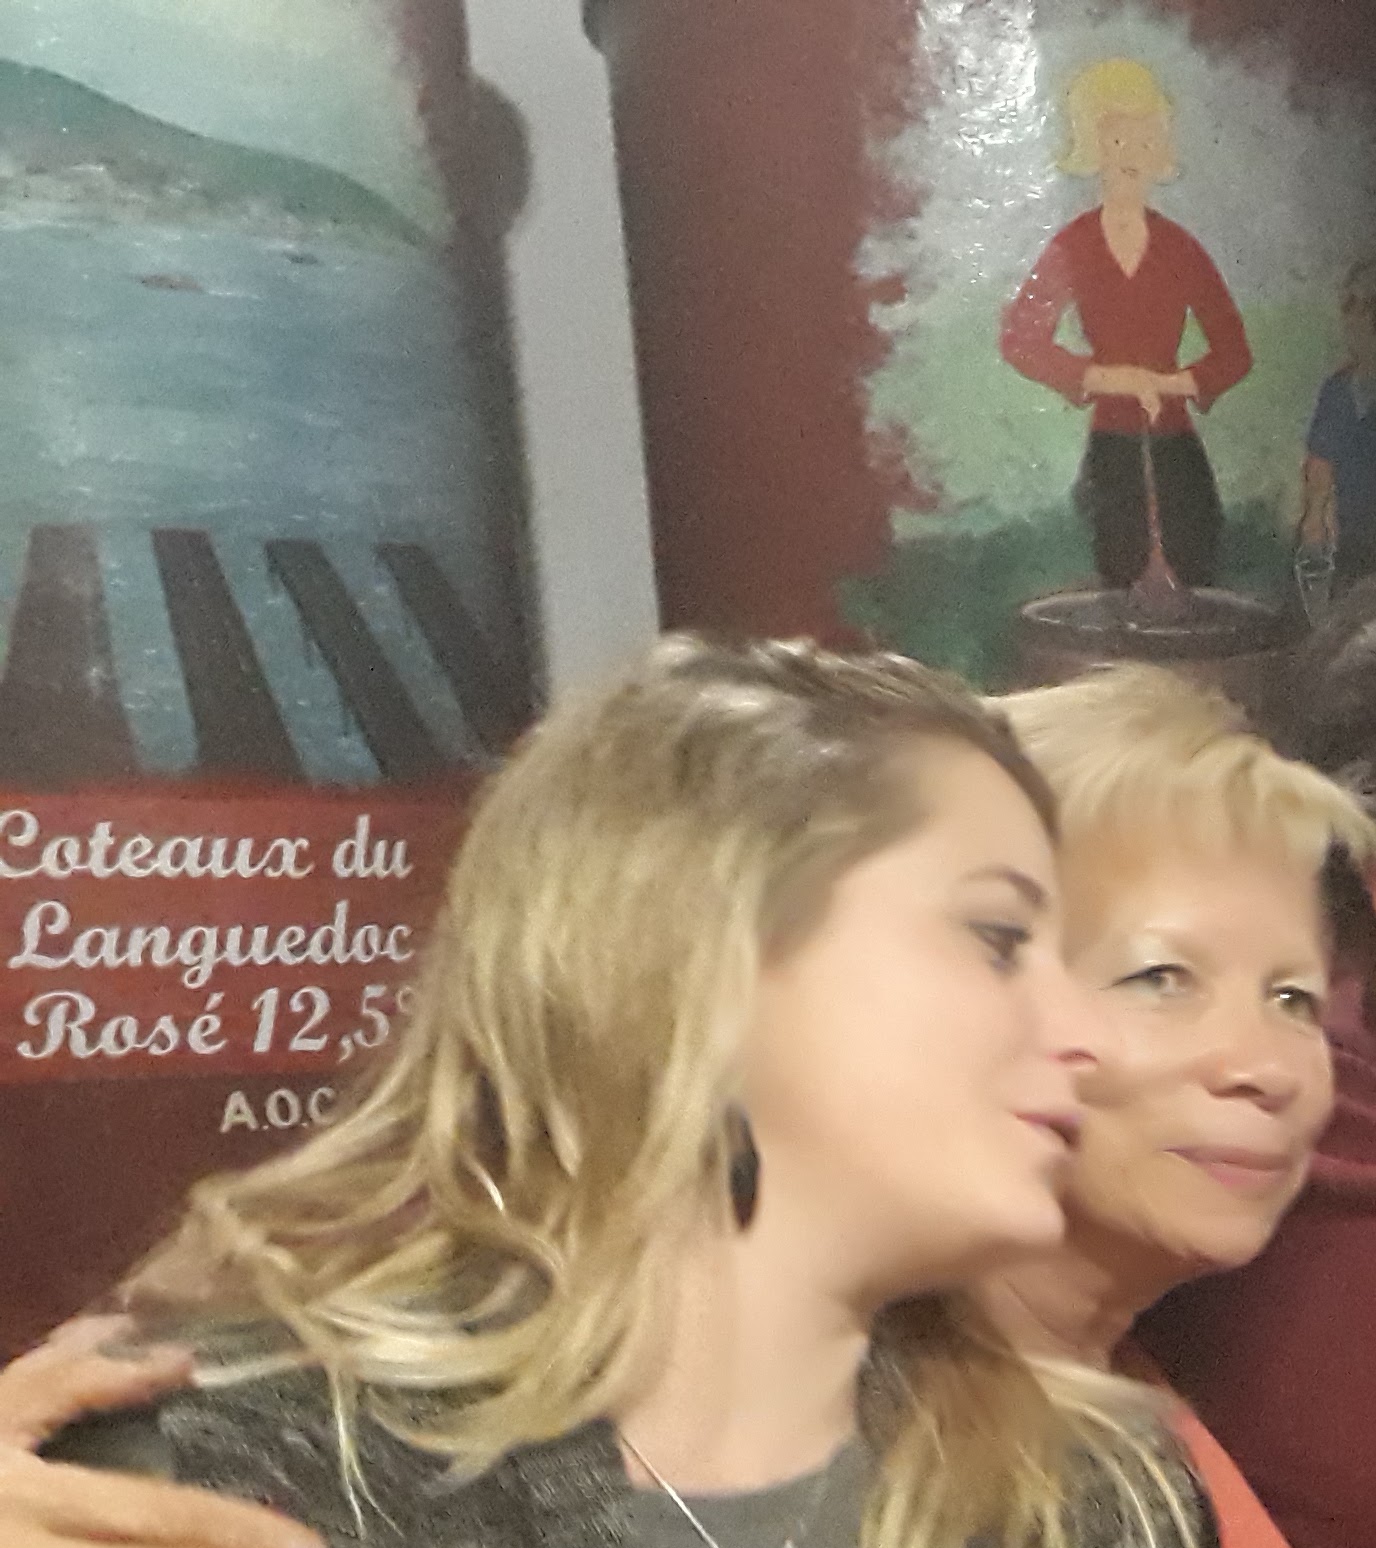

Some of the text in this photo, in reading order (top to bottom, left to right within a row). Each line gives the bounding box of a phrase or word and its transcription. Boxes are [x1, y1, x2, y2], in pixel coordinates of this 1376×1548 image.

[0, 810, 413, 878] Coteaux du
[8, 900, 416, 989] Languedoc
[17, 990, 227, 1059] Rosé
